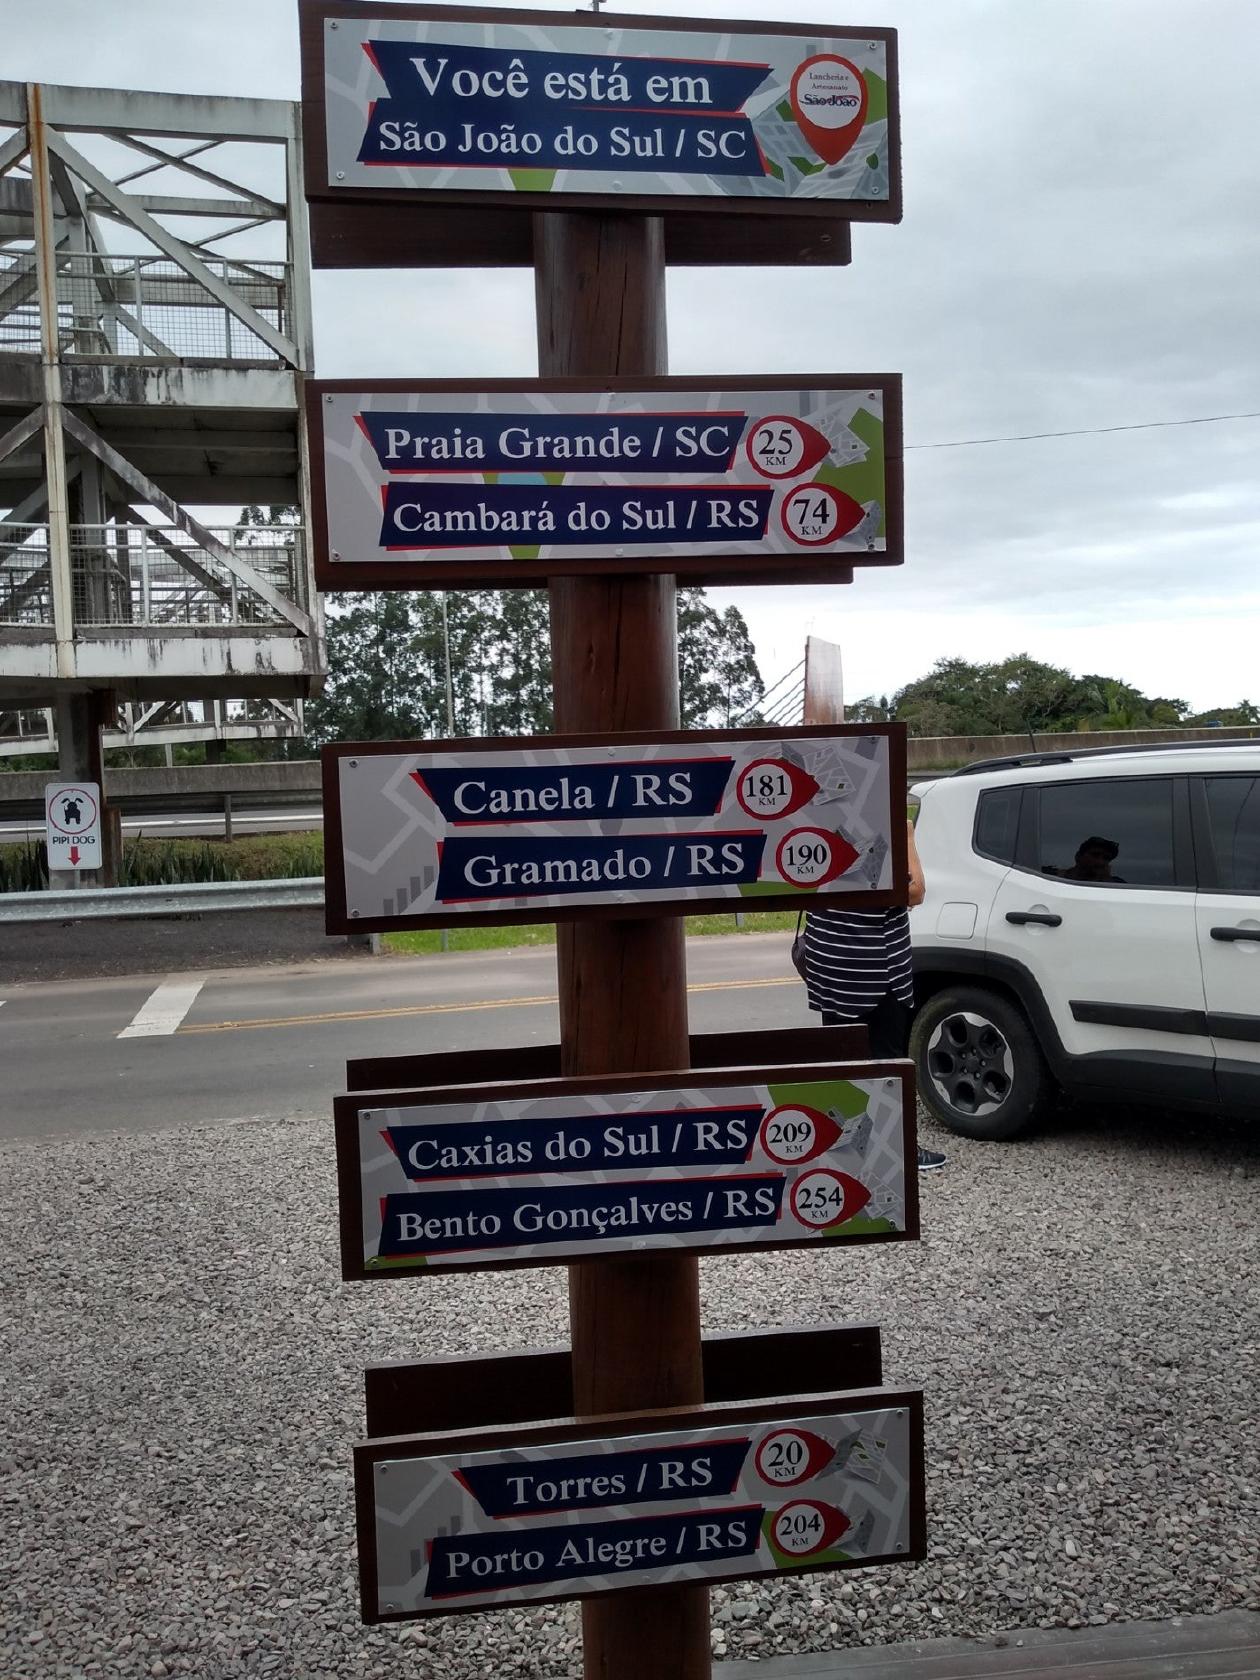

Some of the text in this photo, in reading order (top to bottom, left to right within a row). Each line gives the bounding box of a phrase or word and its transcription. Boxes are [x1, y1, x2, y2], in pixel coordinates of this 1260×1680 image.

[410, 57, 712, 103] Você está em
[809, 72, 844, 81] Lancheria
[379, 122, 745, 159] São João do Sul / SC
[385, 425, 730, 460] Praia Grande / SC
[759, 429, 793, 455] 25
[766, 456, 787, 466] KM
[394, 499, 759, 532] Cambará do Sul / RS
[793, 498, 830, 524] 74
[801, 526, 823, 536] KM
[454, 772, 693, 815] Canela / RS
[745, 775, 788, 797] 181
[759, 798, 776, 806] KM
[52, 836, 95, 845] PIPI DOG
[464, 842, 744, 887] Gramado / RS
[786, 844, 827, 866] 190
[797, 866, 814, 874] KM
[769, 1122, 812, 1143] 209
[408, 1119, 747, 1170] Caxias do Sul / RS
[786, 1145, 803, 1153] KM
[799, 1187, 843, 1209] 254
[397, 1187, 775, 1241] Bento Gonçalves / RS
[811, 1210, 828, 1218] KM
[768, 1441, 803, 1467] 20
[507, 1457, 712, 1504] Torres / RS
[774, 1467, 796, 1477] KM
[780, 1513, 821, 1535] 204
[447, 1521, 747, 1578] Porto Alegre / RS
[792, 1538, 808, 1546] KM
